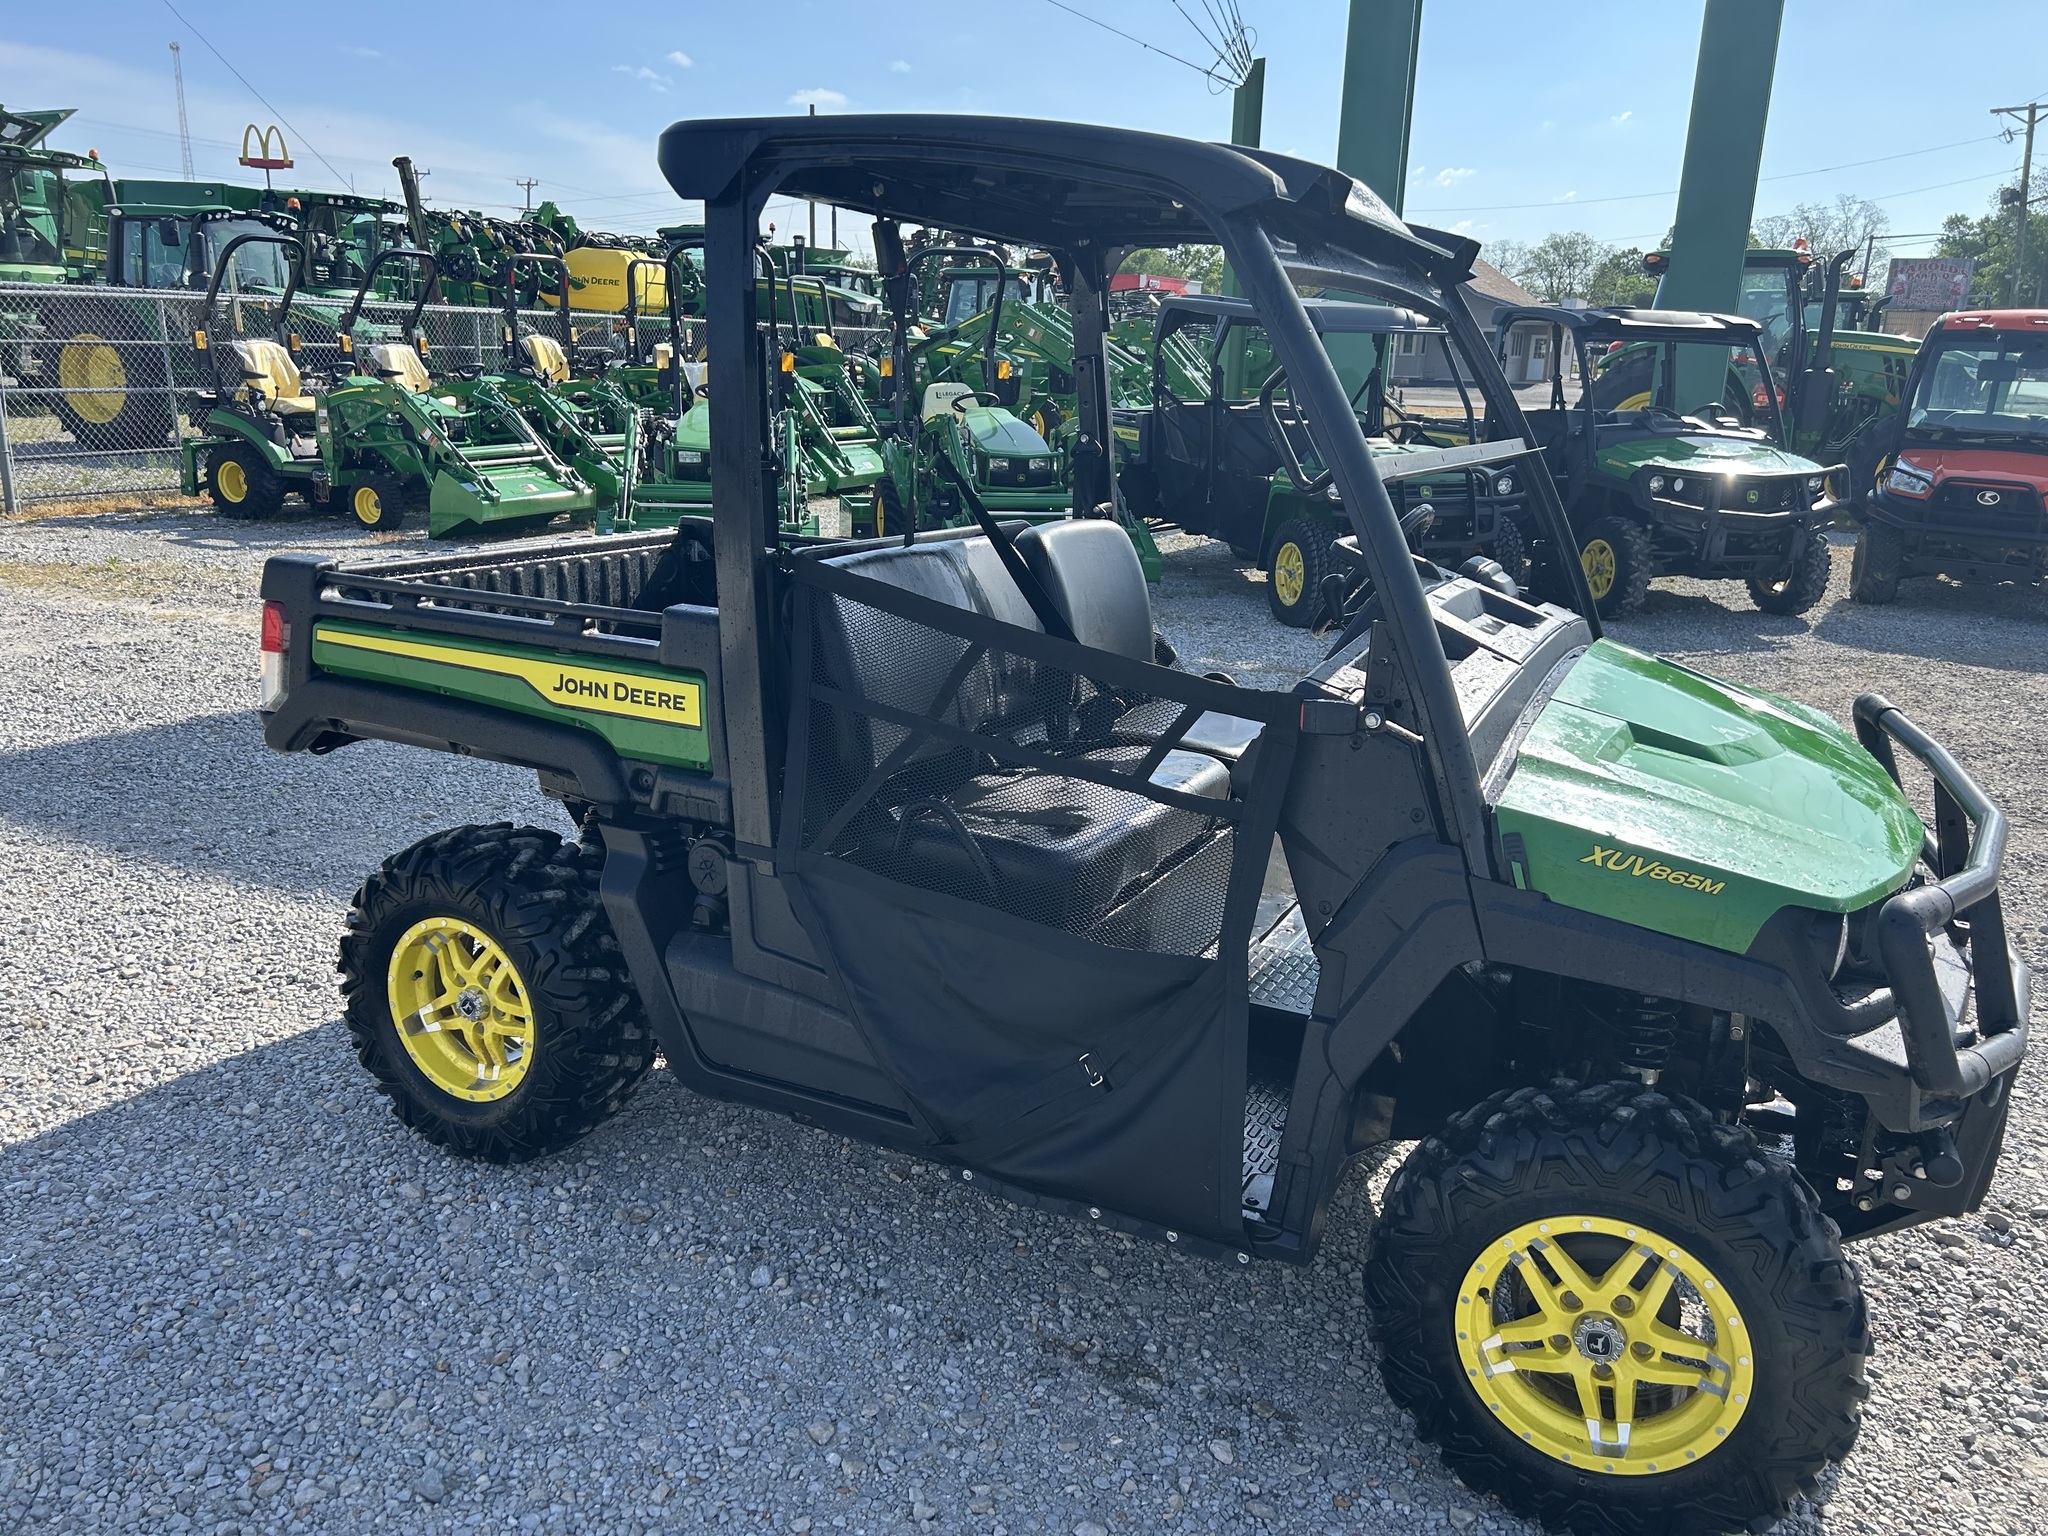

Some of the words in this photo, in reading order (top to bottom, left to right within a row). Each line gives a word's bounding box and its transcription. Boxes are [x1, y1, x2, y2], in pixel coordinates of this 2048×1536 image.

[591, 276, 620, 286] DEERE
[1849, 343, 1872, 351] DEERE
[553, 673, 608, 699] JOHN
[614, 682, 686, 712] DEERE
[1577, 844, 1728, 895] XUV865M
